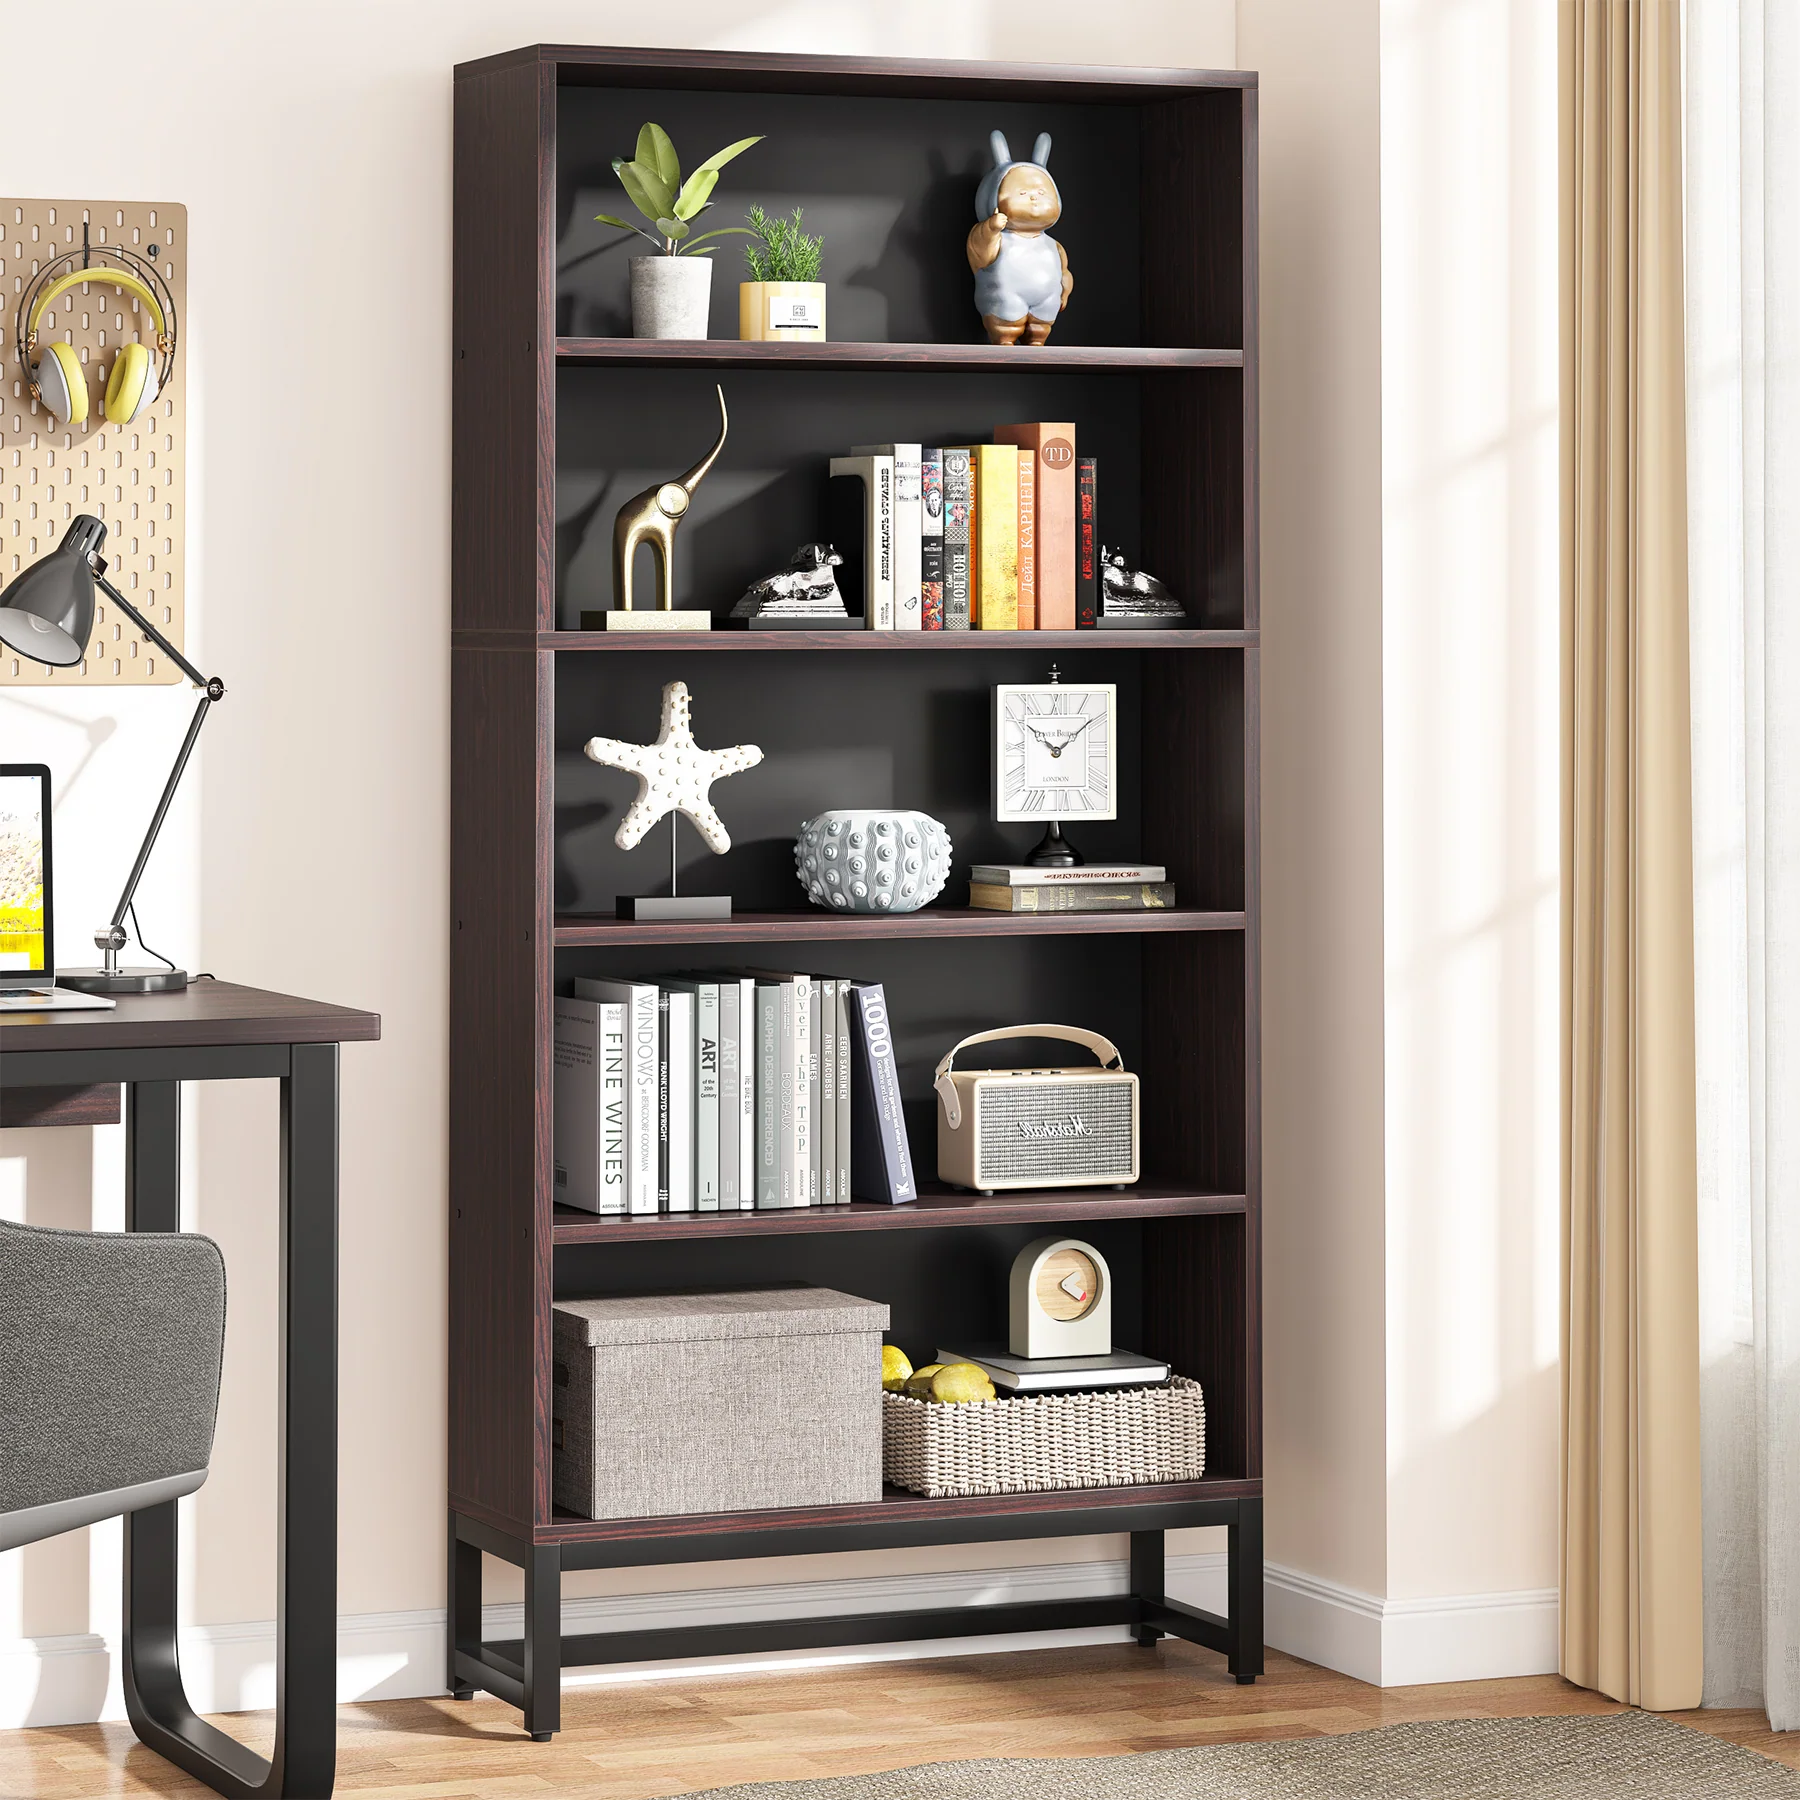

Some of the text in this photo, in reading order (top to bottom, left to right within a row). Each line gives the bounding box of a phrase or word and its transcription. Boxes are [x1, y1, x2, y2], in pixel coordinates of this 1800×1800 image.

[1045, 447, 1071, 462] TD
[1020, 460, 1034, 594] Дейл КАРНЕГИ
[953, 554, 968, 607] ЛОНДОН
[637, 993, 654, 1086] WINDOWS
[764, 1005, 774, 1053] GRAPHIC
[862, 992, 891, 1058] 1000
[701, 1037, 717, 1073] ART
[722, 1036, 737, 1073] ART
[764, 1055, 774, 1094] DESIGN
[839, 1036, 847, 1100] EERO SAARINEN
[605, 1033, 623, 1185] FINE WINES
[641, 1095, 650, 1133] BERGDORF
[781, 1072, 792, 1130] BORDEAUX
[660, 1111, 668, 1142] WRIGHT
[764, 1097, 774, 1166] REFERENCED
[640, 1133, 650, 1172] GOODMAN
